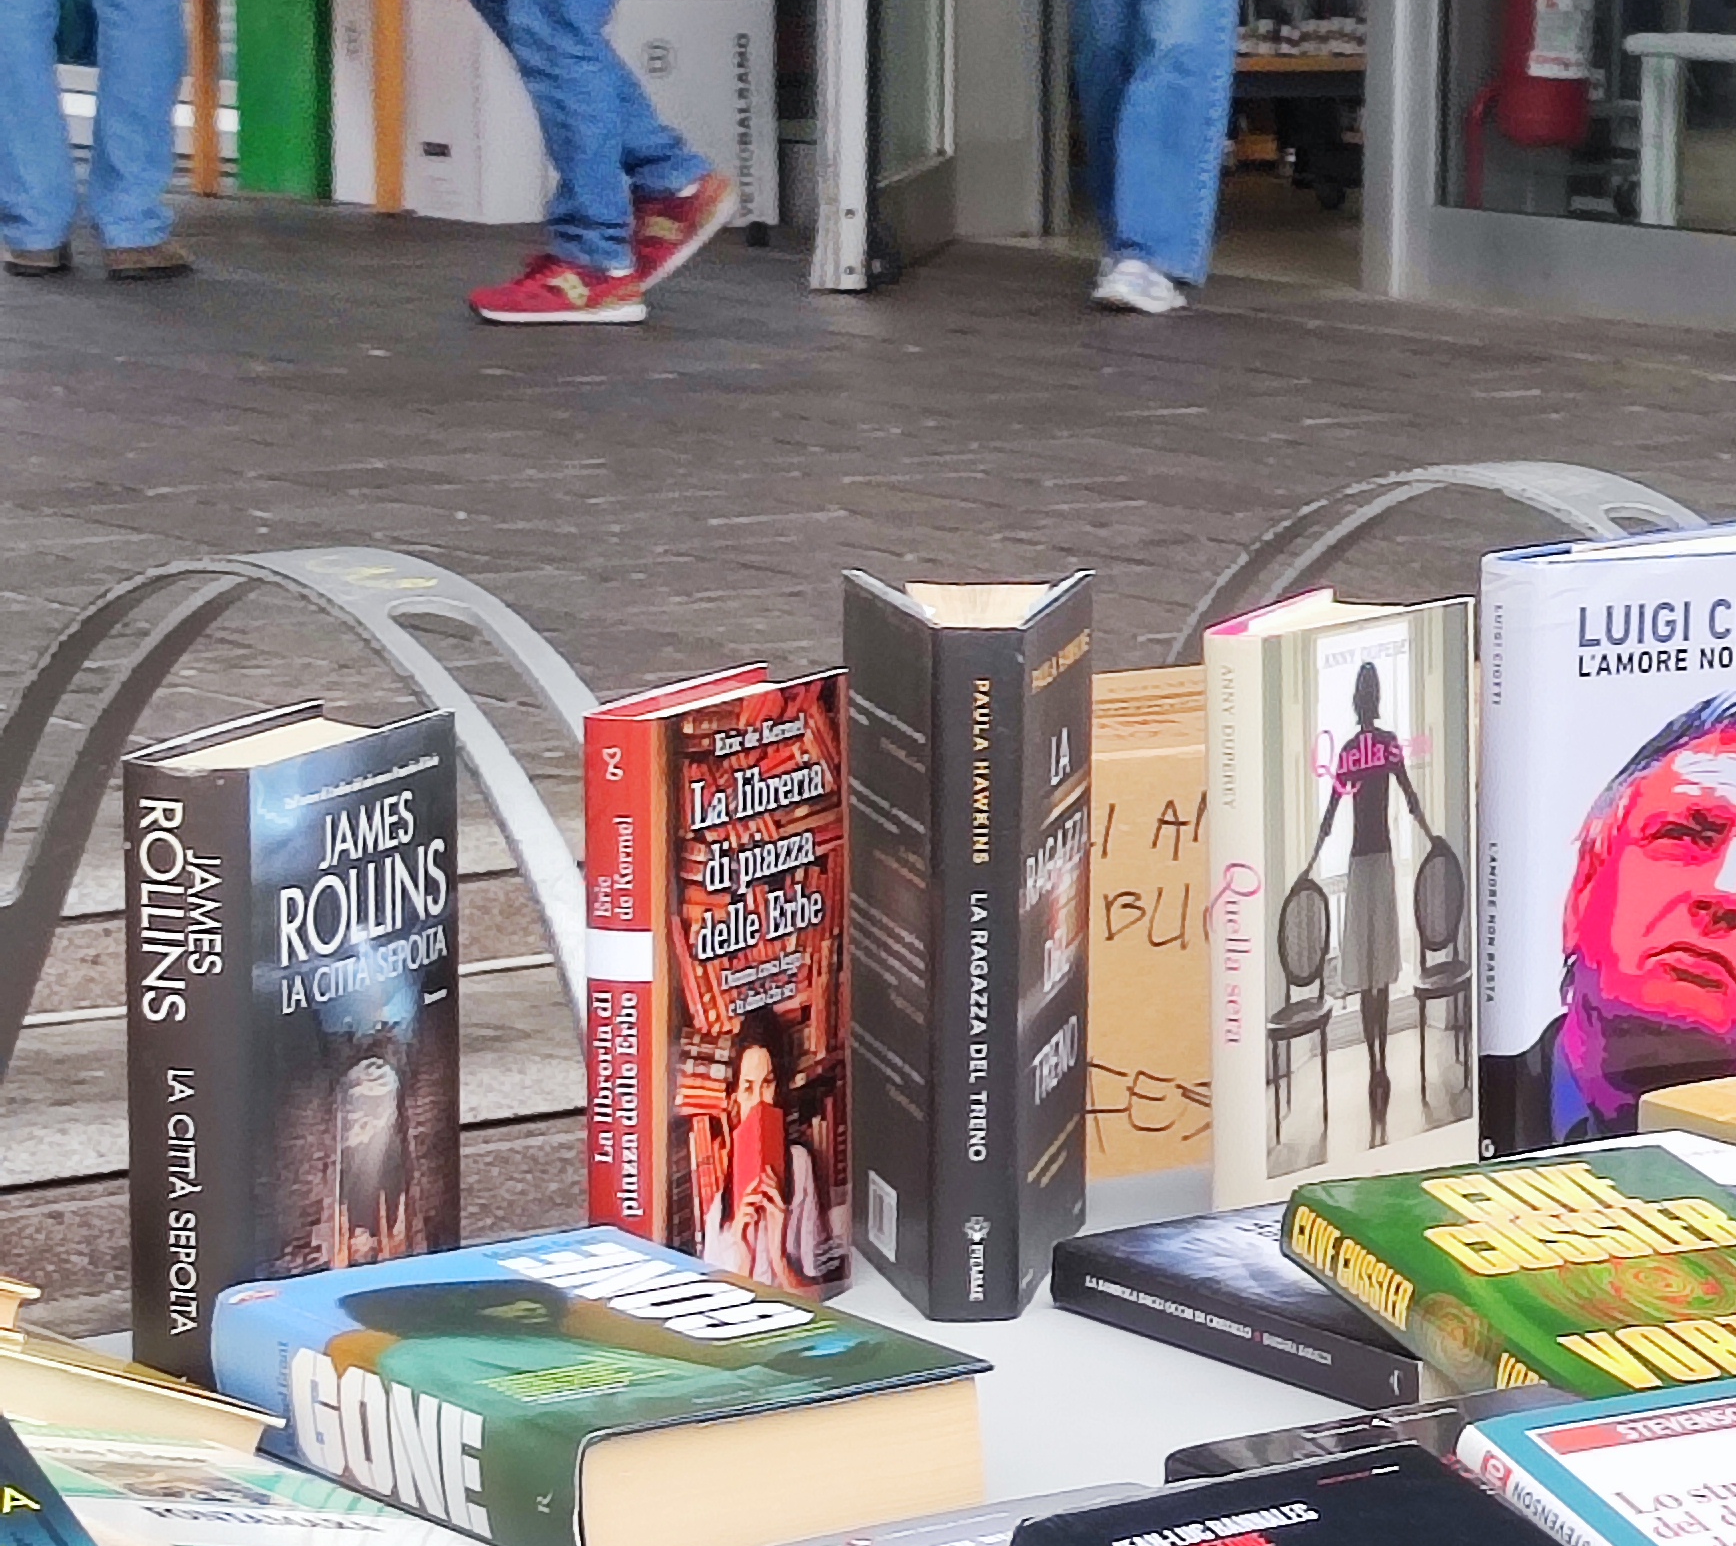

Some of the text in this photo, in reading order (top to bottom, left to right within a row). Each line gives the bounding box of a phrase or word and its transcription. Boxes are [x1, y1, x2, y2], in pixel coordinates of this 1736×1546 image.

[1578, 600, 1692, 648] LUIGI
[1221, 664, 1236, 716] ANNY
[1578, 648, 1689, 678] L'AMORE
[973, 678, 991, 752] PAULA
[690, 753, 825, 831] La libreria
[1049, 727, 1071, 787] LA
[319, 790, 414, 870] JAMES
[705, 831, 815, 895] di piazza
[139, 797, 187, 1022] ROLLINS
[186, 848, 223, 976] JAMES
[279, 838, 448, 968] ROLLINS
[697, 883, 823, 960] delle Erbe
[1102, 881, 1212, 953] BU
[281, 974, 308, 1015] LA
[376, 924, 448, 983] SEPOLTA
[967, 889, 989, 1163] LA RAGAZZA DEL TRENO
[1224, 983, 1244, 1045] sera
[1032, 1014, 1079, 1106] TRENO
[593, 1131, 613, 1164] La
[616, 1133, 644, 1218] piazza
[166, 1068, 202, 1336] LA CITTÀ SEPOLTA
[1421, 1162, 1617, 1217] CLIVE
[1291, 1205, 1416, 1332] CLIVE CUSSLER
[290, 1347, 493, 1539] GONE
[1613, 1490, 1685, 1516] Lo
[1653, 1509, 1711, 1540] del
